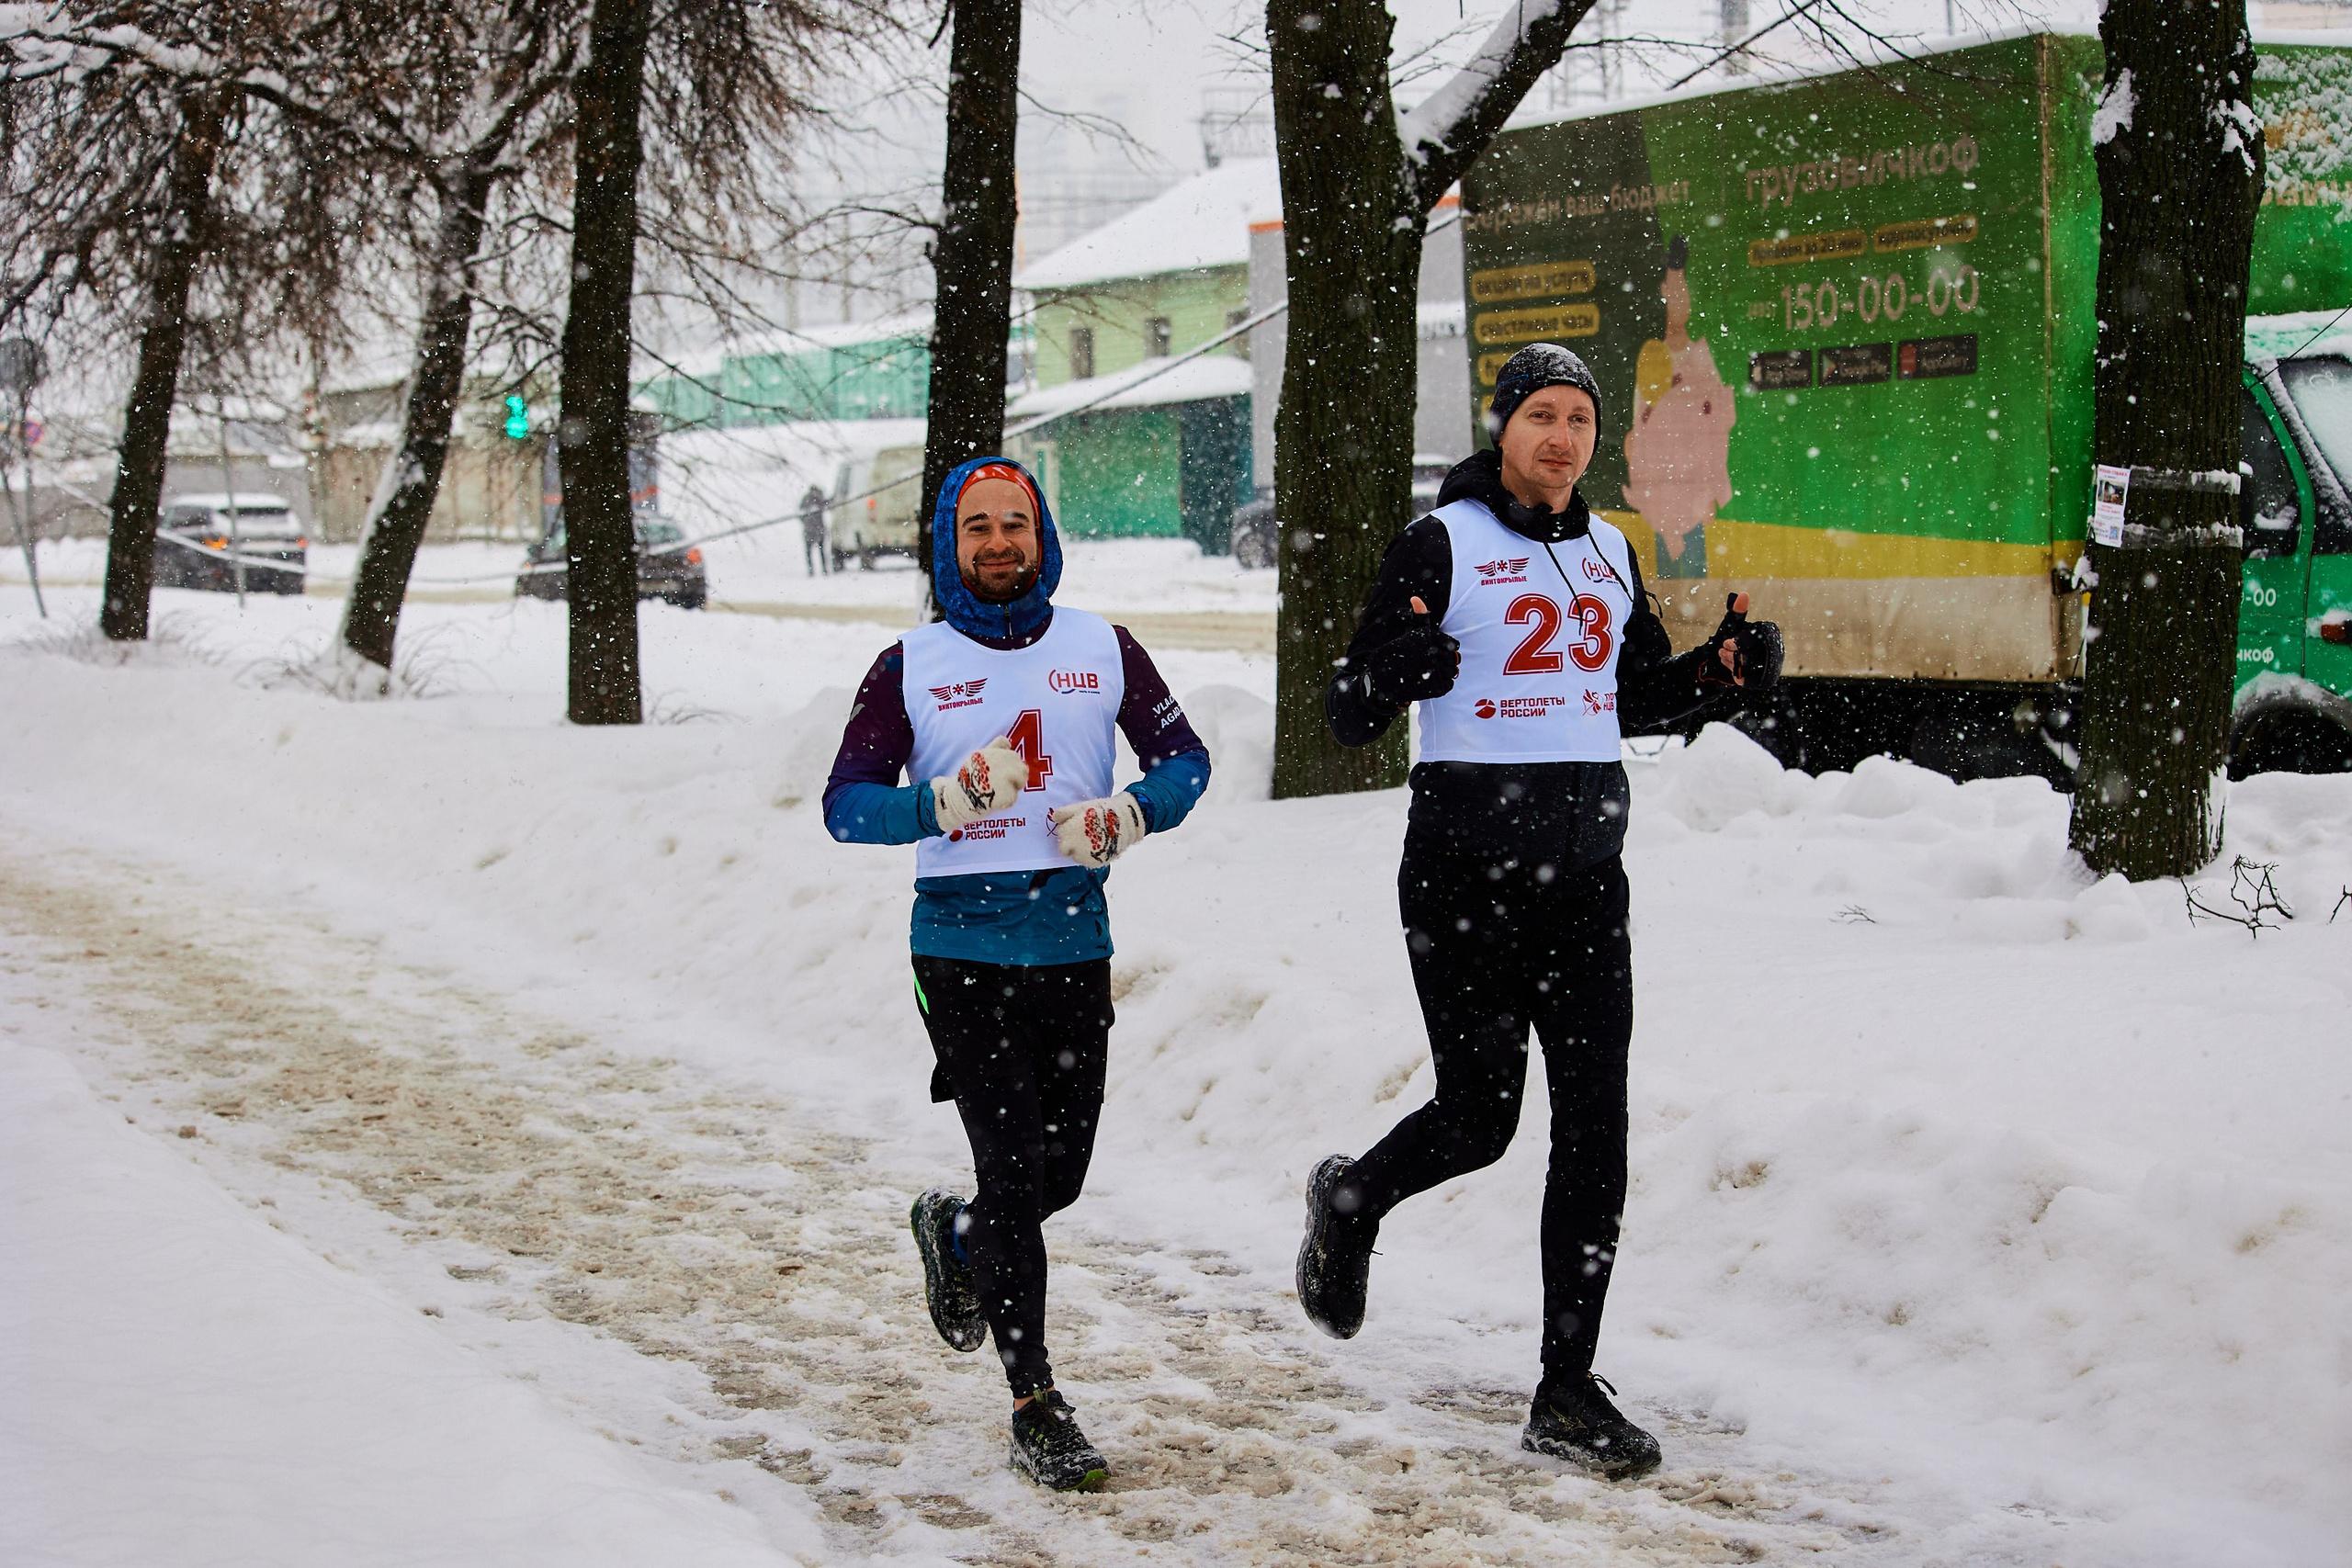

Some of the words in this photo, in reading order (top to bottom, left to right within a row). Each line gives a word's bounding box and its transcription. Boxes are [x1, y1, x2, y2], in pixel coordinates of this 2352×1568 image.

[1746, 131, 1979, 209] грузовичкоф
[1566, 195, 1605, 216] ваш
[1611, 180, 1690, 213] бюджет
[1781, 265, 1980, 330] 150-00-00
[1588, 561, 1619, 581] НЦ
[1481, 575, 1528, 586] ВИНТОКРЫЛЫЕ
[2241, 588, 2277, 607] -00
[1503, 592, 1613, 676] 23
[1057, 672, 1099, 689] НЦВ
[938, 697, 984, 712] ВИНТОКРЫЛЫЕ
[1500, 695, 1566, 708] ВЕРТОЛЕТЫ
[1500, 707, 1546, 718] РОССИИ
[1006, 708, 1054, 793] 4
[964, 817, 1026, 830] ВЕРТОЛЕТЫ
[966, 829, 1006, 840] РОССИИ
